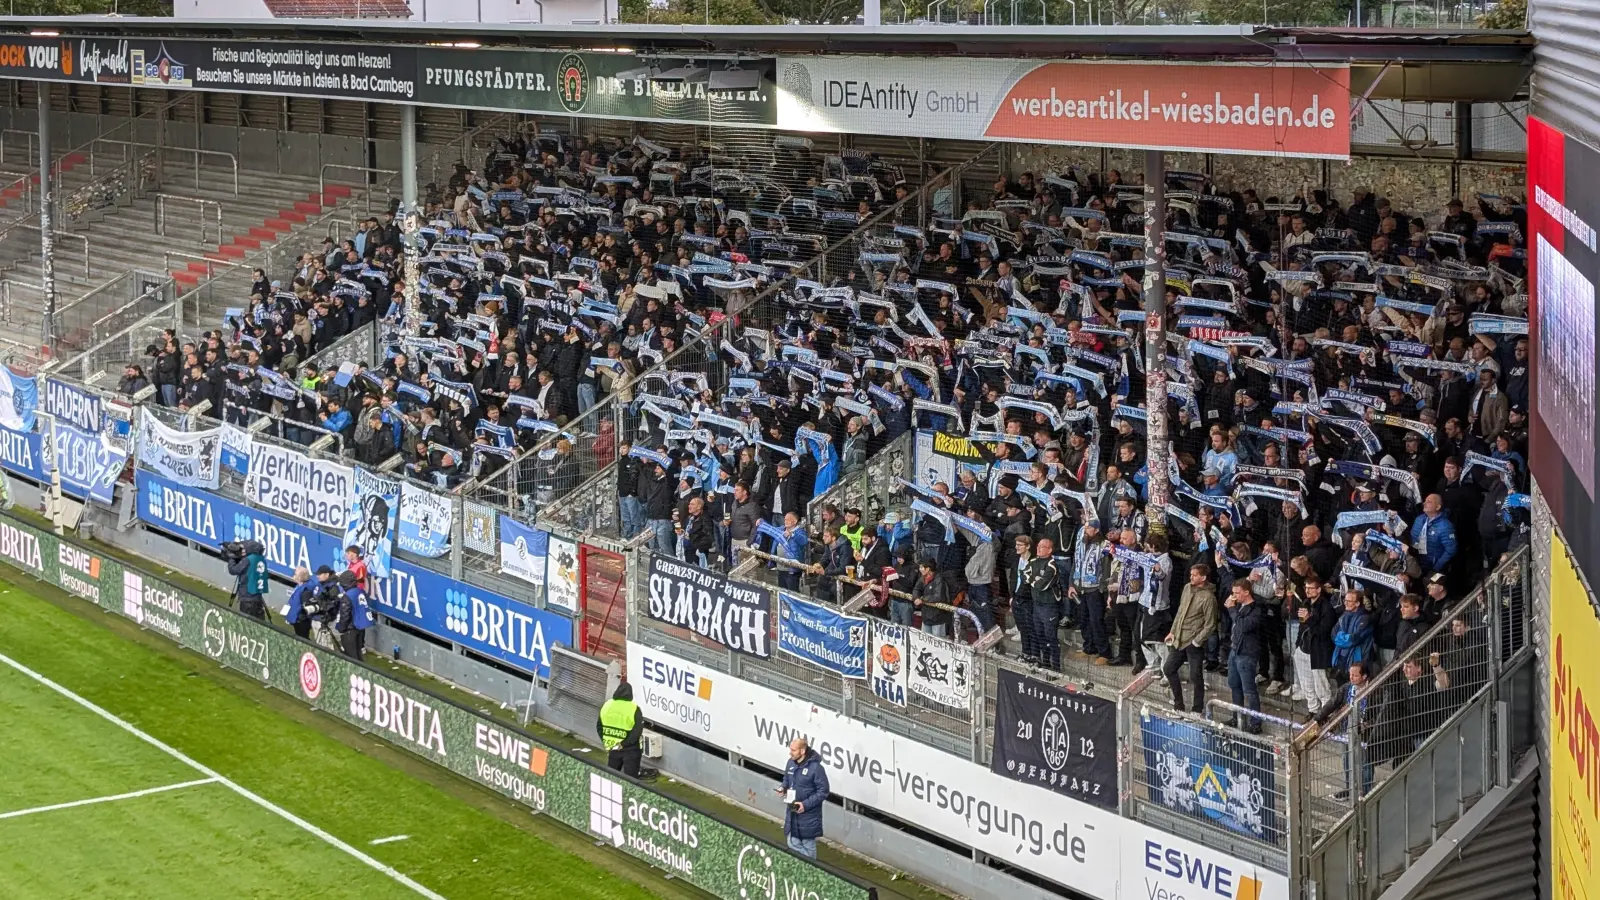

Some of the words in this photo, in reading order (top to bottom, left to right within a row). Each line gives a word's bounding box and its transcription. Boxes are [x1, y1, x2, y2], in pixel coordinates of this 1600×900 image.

[0, 44, 26, 67] OCK
[28, 45, 59, 69] YOU!
[212, 48, 238, 62] Frische
[240, 50, 254, 63] und
[256, 49, 303, 67] Regionalität
[305, 51, 323, 69] liegt
[325, 54, 340, 66] uns
[341, 55, 356, 68] am
[358, 54, 391, 69] Herzen!
[197, 67, 232, 83] Besuchen
[233, 69, 245, 83] Sie
[246, 72, 272, 85] unsere
[273, 70, 302, 87] Märkte
[303, 72, 312, 87] in
[313, 73, 340, 89] Idstein
[342, 74, 350, 89] &
[351, 73, 369, 91] Bad
[370, 76, 414, 97] Camberg
[426, 67, 551, 93] PFUNGSTÄDTER.
[597, 76, 626, 95] DIE
[823, 80, 919, 118] IDEAntity
[926, 91, 979, 114] GmbH
[1012, 87, 1336, 129] werbeartikel-wiesbaden.de
[46, 381, 99, 431] HADERN
[250, 444, 348, 498] Vierkirchen
[163, 486, 217, 540] BRITA
[258, 476, 351, 529] Pasenbach
[1, 522, 44, 572] BRITA
[59, 543, 90, 575] ESWE
[253, 518, 313, 576] BRITA
[59, 567, 100, 604] Versorgung
[144, 584, 184, 618] accadis
[369, 568, 423, 619] RITA
[144, 608, 181, 639] Hochschule
[470, 596, 551, 667] BRITA
[649, 573, 769, 657] SIMBACH
[780, 624, 862, 669] Frontenhausen
[642, 656, 696, 697] ESWE
[912, 682, 938, 700] GEGEN
[1018, 682, 1094, 715] Reisegruppe
[373, 683, 447, 757] BRITA
[642, 684, 711, 732] Versorgung
[1016, 719, 1033, 740] 20
[475, 722, 530, 770] ESWE
[603, 727, 628, 739] TEWARD
[1046, 746, 1065, 766] 1860
[1080, 737, 1095, 758] 12
[1568, 664, 1600, 822] LOTT
[475, 755, 545, 811] Versorgung
[753, 714, 1086, 864] wwweswe-versorgung.de
[627, 797, 698, 849] accadis
[1568, 775, 1592, 878] Hessen
[627, 829, 693, 876] Hochschule
[1145, 839, 1232, 899] ESWE
